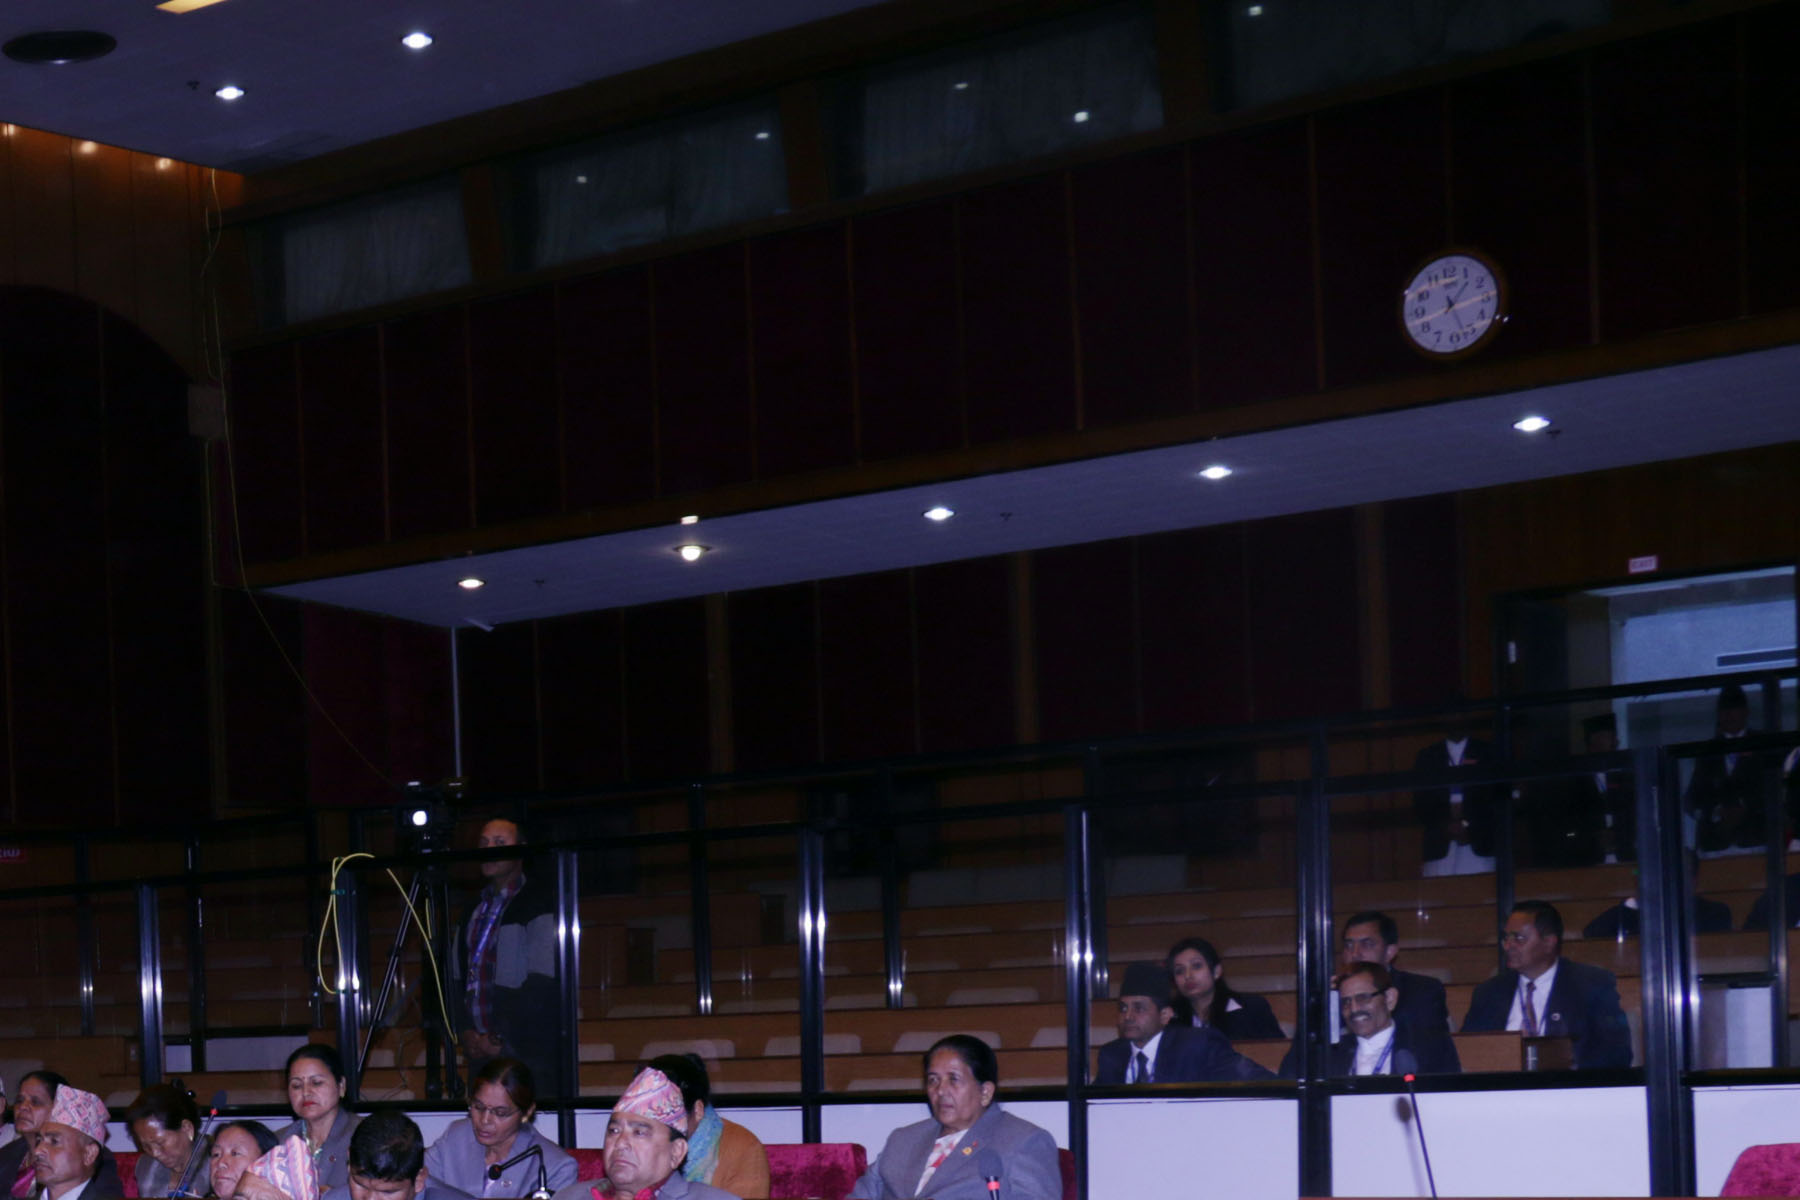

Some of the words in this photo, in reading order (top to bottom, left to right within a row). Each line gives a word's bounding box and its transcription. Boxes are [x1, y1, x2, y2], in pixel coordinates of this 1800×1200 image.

[1443, 266, 1456, 278] 12
[1475, 276, 1485, 289] 2
[1481, 290, 1491, 303] 3
[1414, 306, 1426, 318] 9
[1422, 321, 1431, 333] 8
[1434, 331, 1442, 343] 7
[1450, 331, 1461, 344] 6
